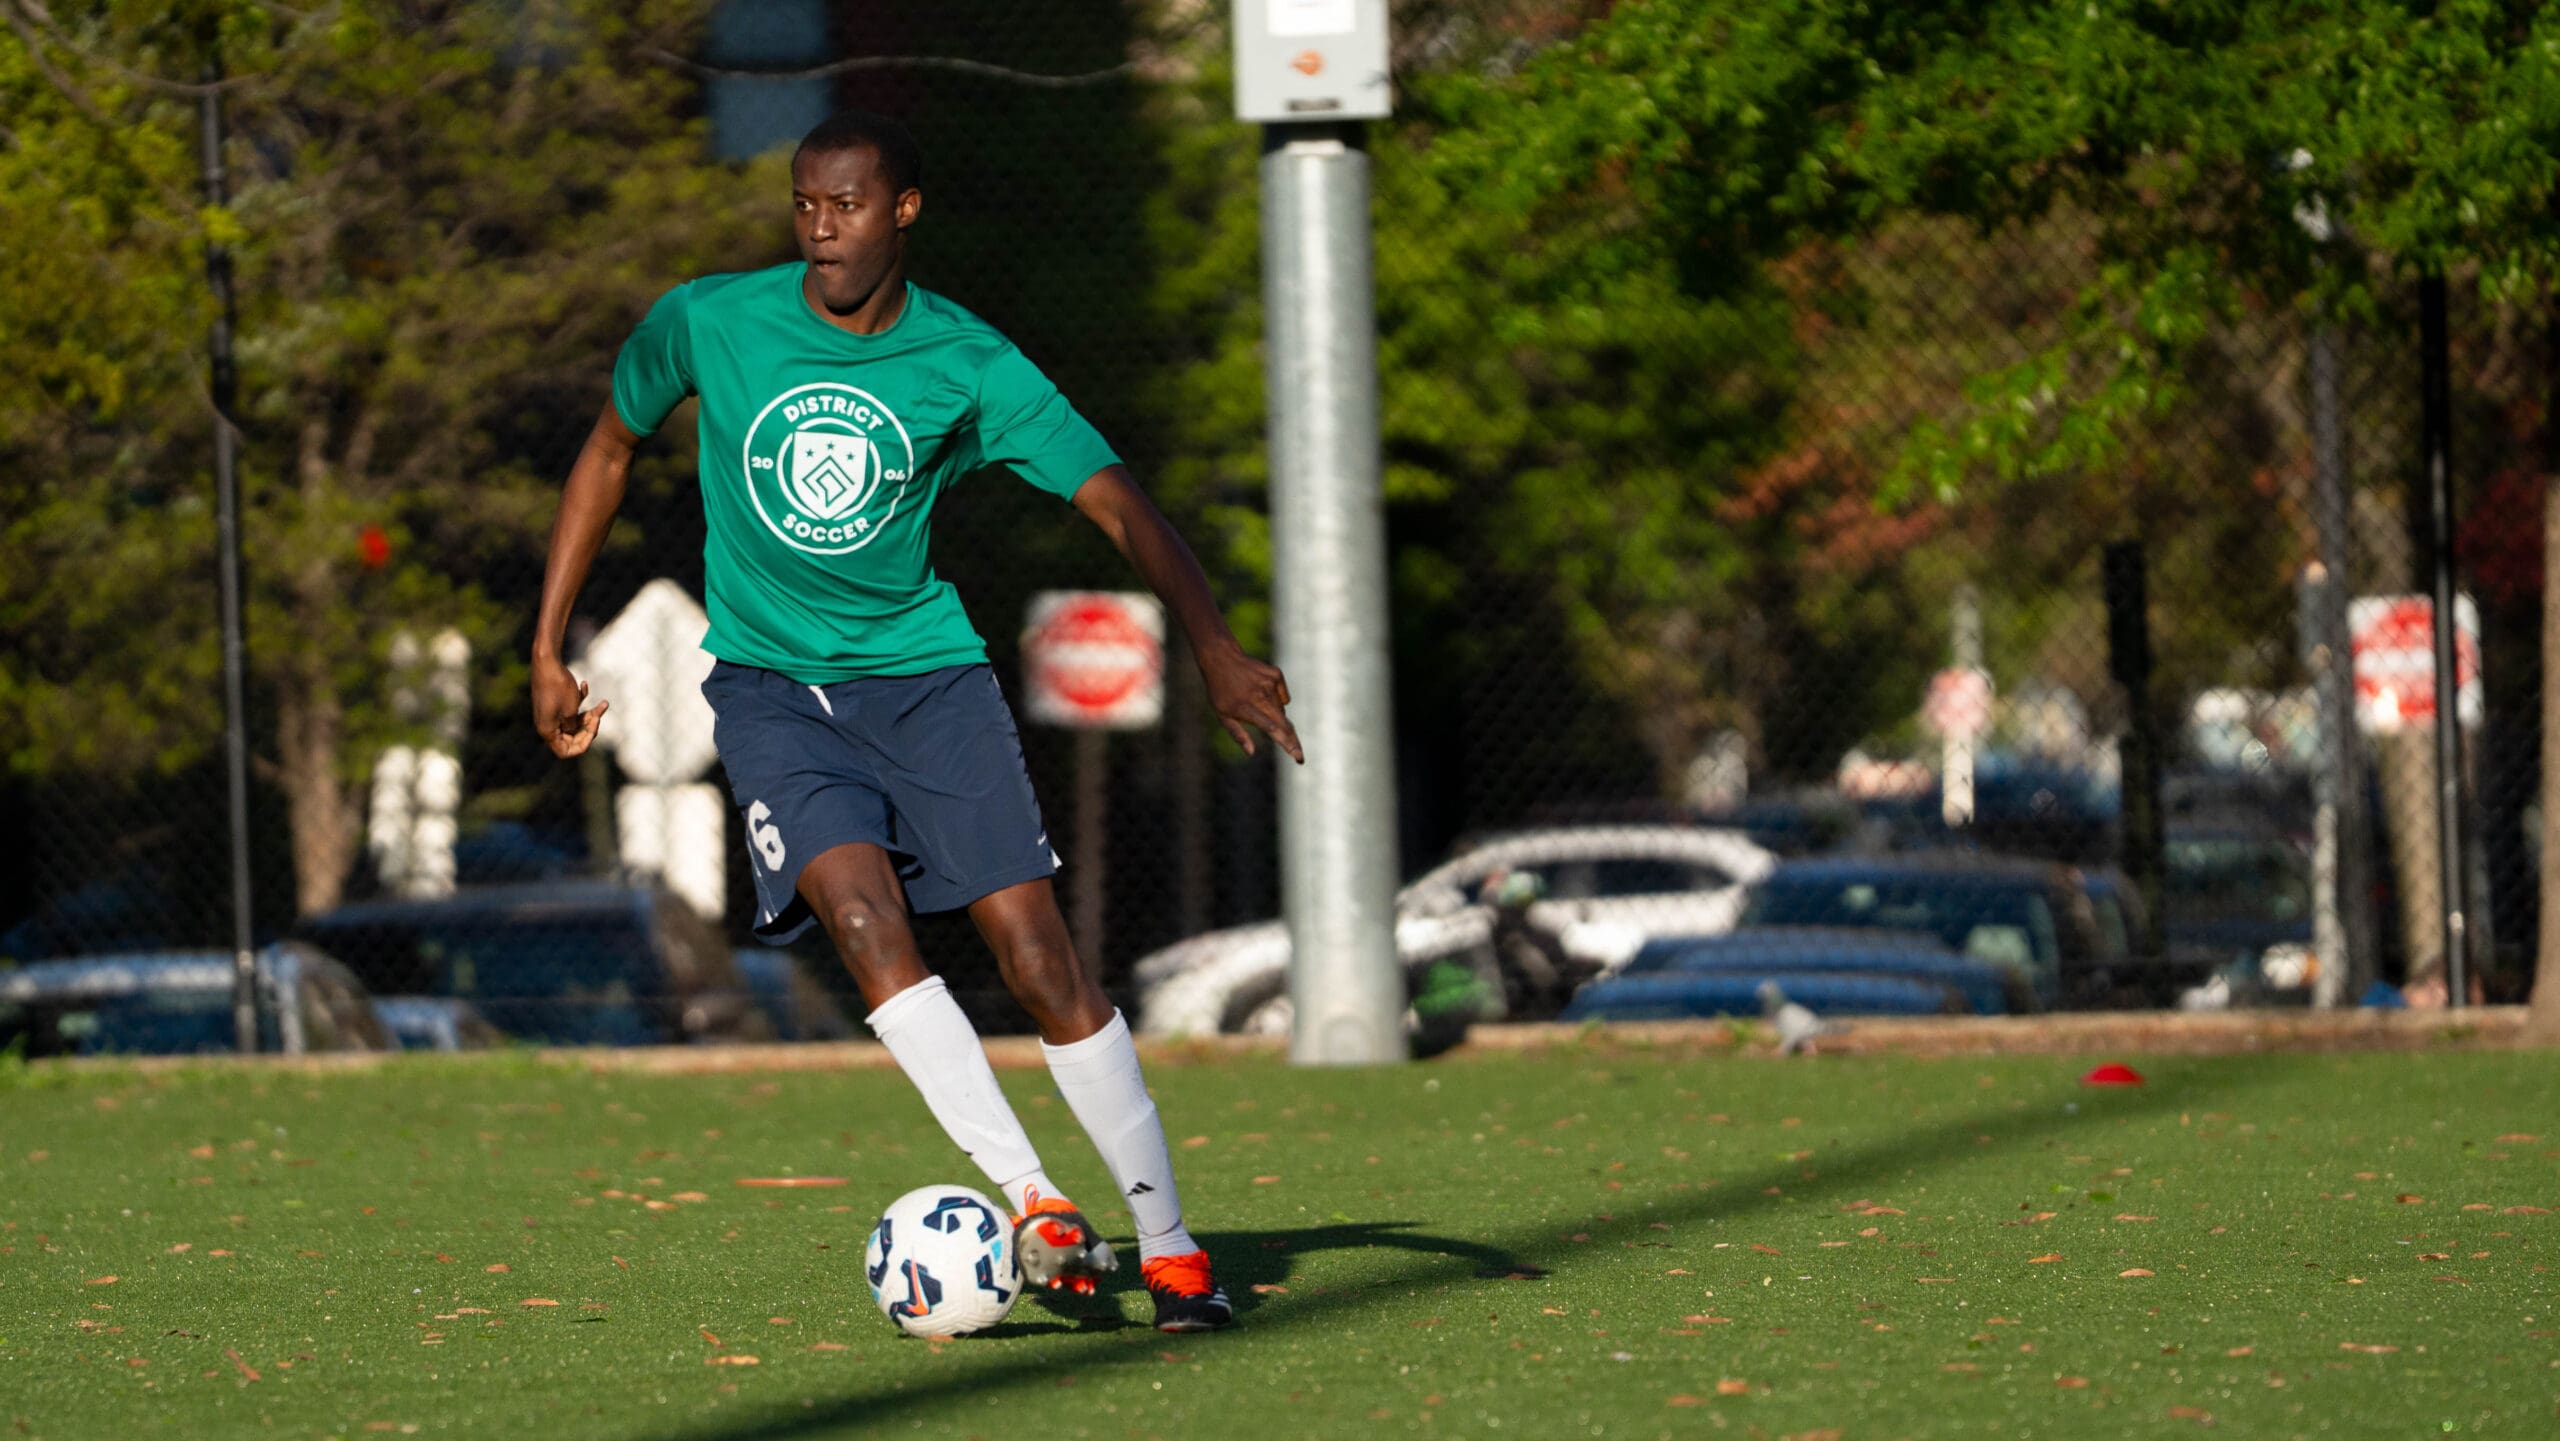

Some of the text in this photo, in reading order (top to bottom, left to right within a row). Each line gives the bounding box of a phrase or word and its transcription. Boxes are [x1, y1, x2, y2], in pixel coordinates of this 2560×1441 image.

[782, 395, 884, 431] DISTRICT
[751, 456, 774, 470] 20
[782, 513, 870, 543] SOCCER
[748, 799, 785, 872] 6
